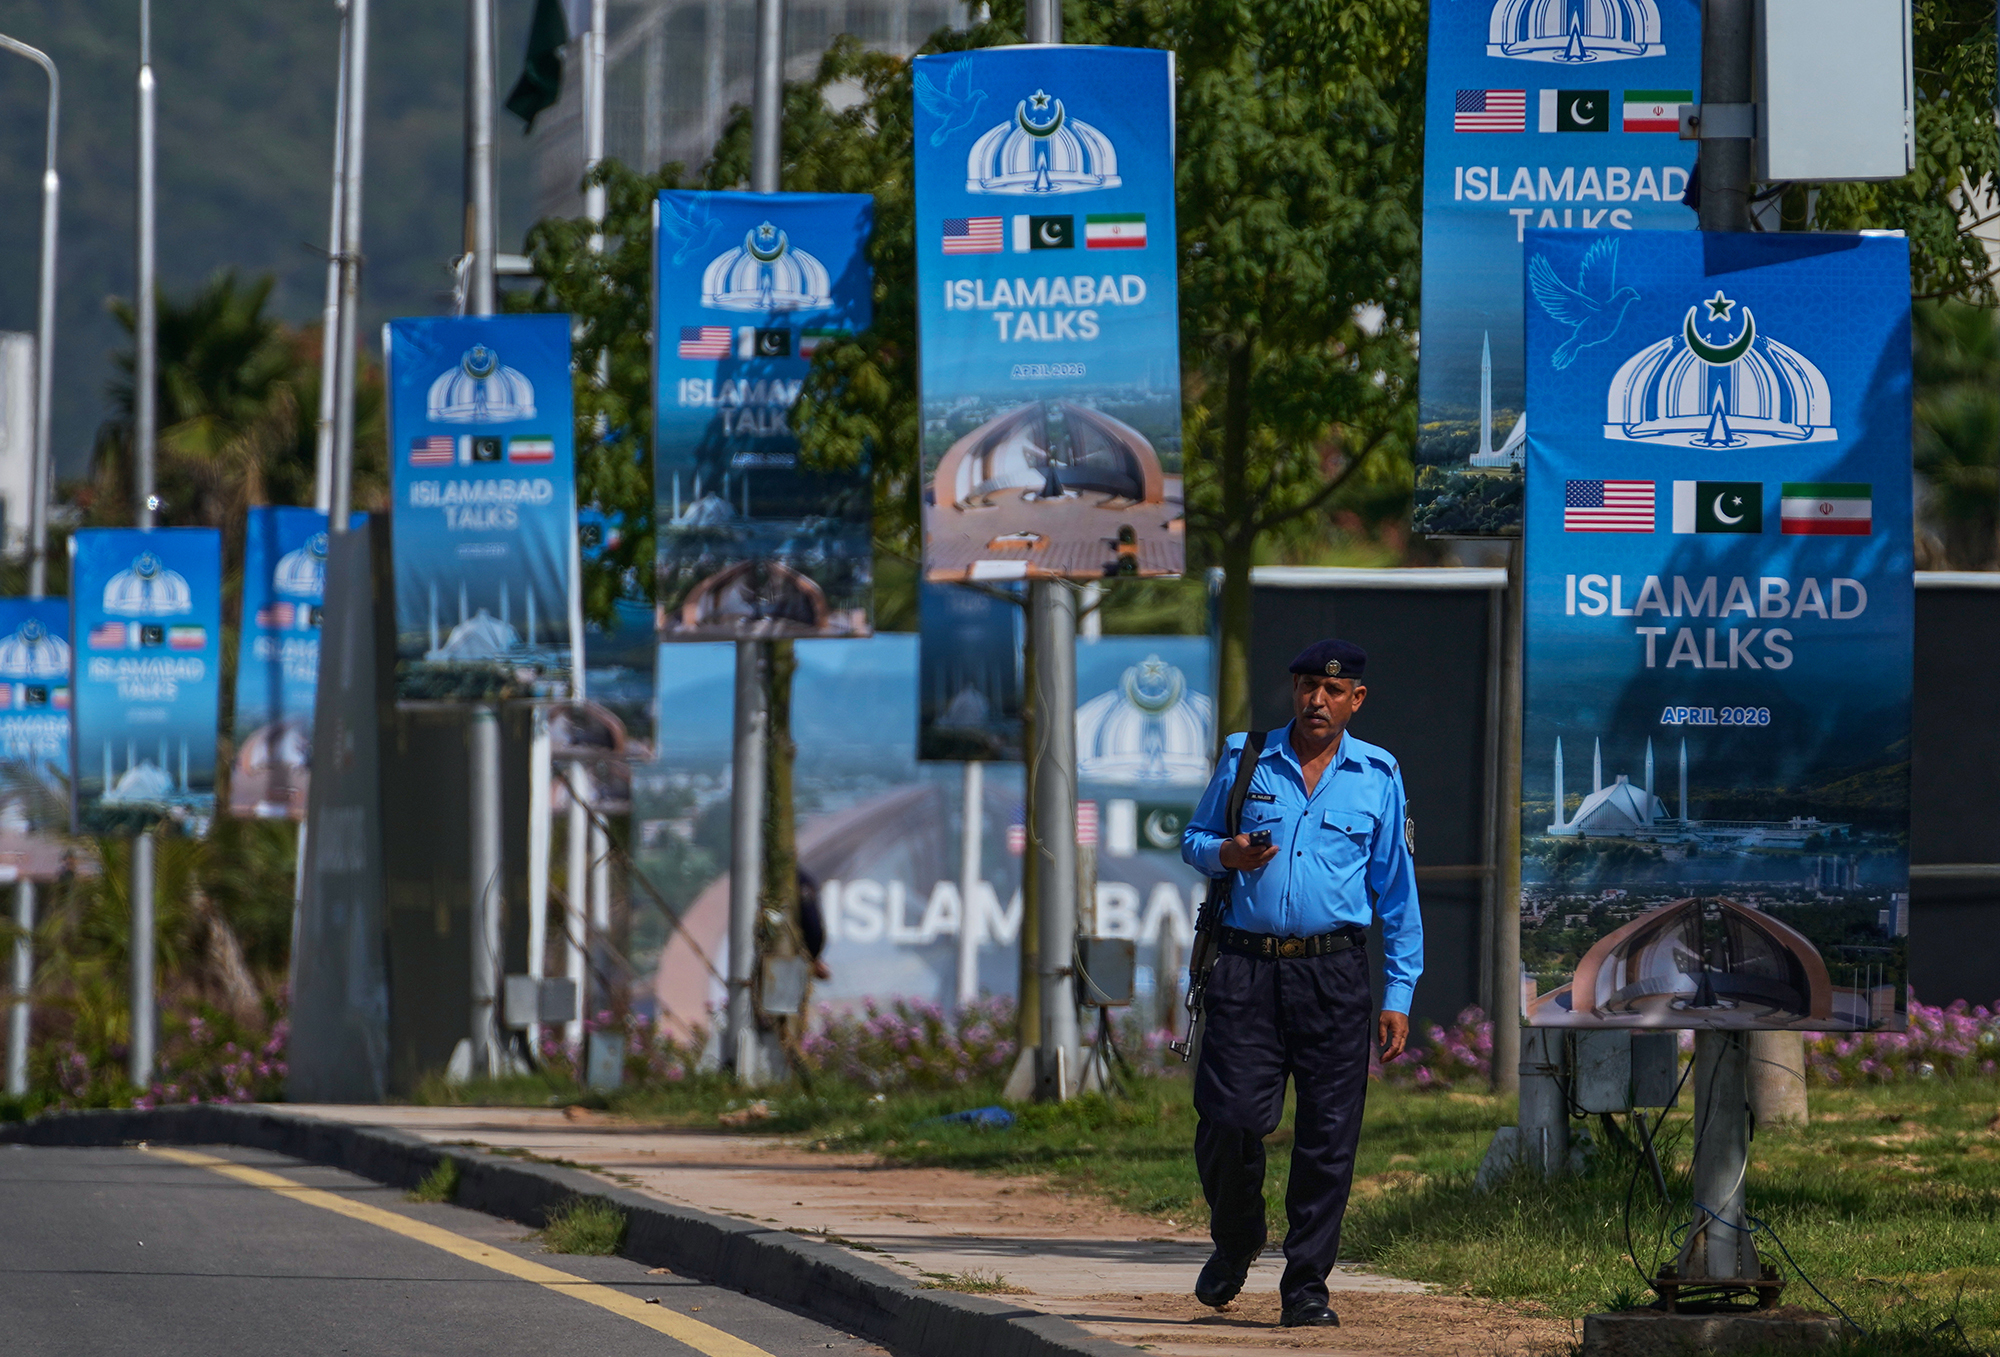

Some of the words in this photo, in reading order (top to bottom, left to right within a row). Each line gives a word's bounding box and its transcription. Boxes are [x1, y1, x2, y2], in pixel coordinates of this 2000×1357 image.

[1454, 165, 1690, 202] ISLAMABAD
[944, 275, 1146, 310] ISLAMABAD
[993, 310, 1100, 342] TALKS
[1011, 364, 1050, 379] APRIL
[720, 407, 792, 437] TALK
[409, 478, 554, 507] ISLAMABAD
[445, 504, 519, 531] TALKS
[1565, 573, 1868, 620] ISLAMABAD
[1636, 626, 1794, 669] TALKS
[1660, 706, 1718, 725] APRIL
[1720, 707, 1771, 726] 2026
[820, 879, 1208, 947] ISLAMBA
